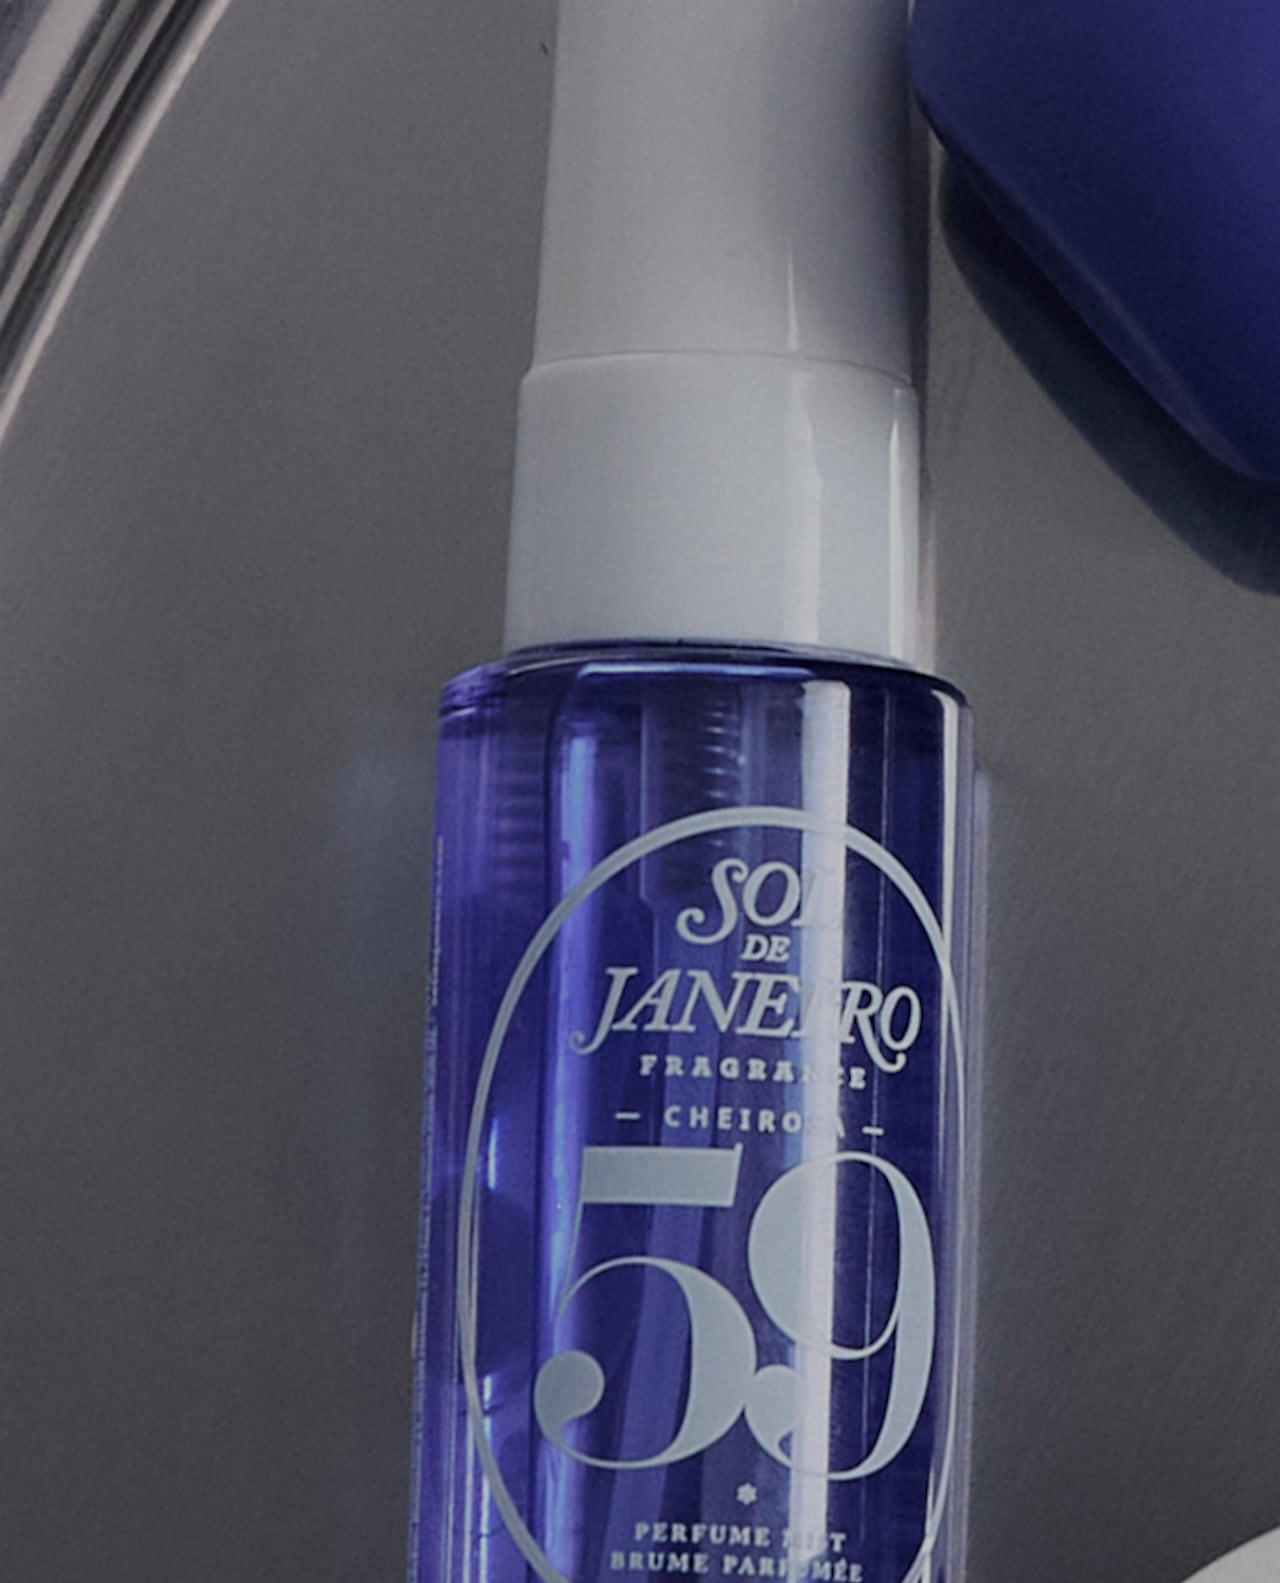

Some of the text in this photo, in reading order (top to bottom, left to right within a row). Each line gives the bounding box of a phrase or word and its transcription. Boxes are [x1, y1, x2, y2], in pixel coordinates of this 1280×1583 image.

[741, 933, 791, 962] DE
[663, 1106, 846, 1139] CHEIRO
[533, 1142, 936, 1482] 59
[634, 1521, 847, 1553] PERFUME MT
[610, 1550, 710, 1574] BRUME
